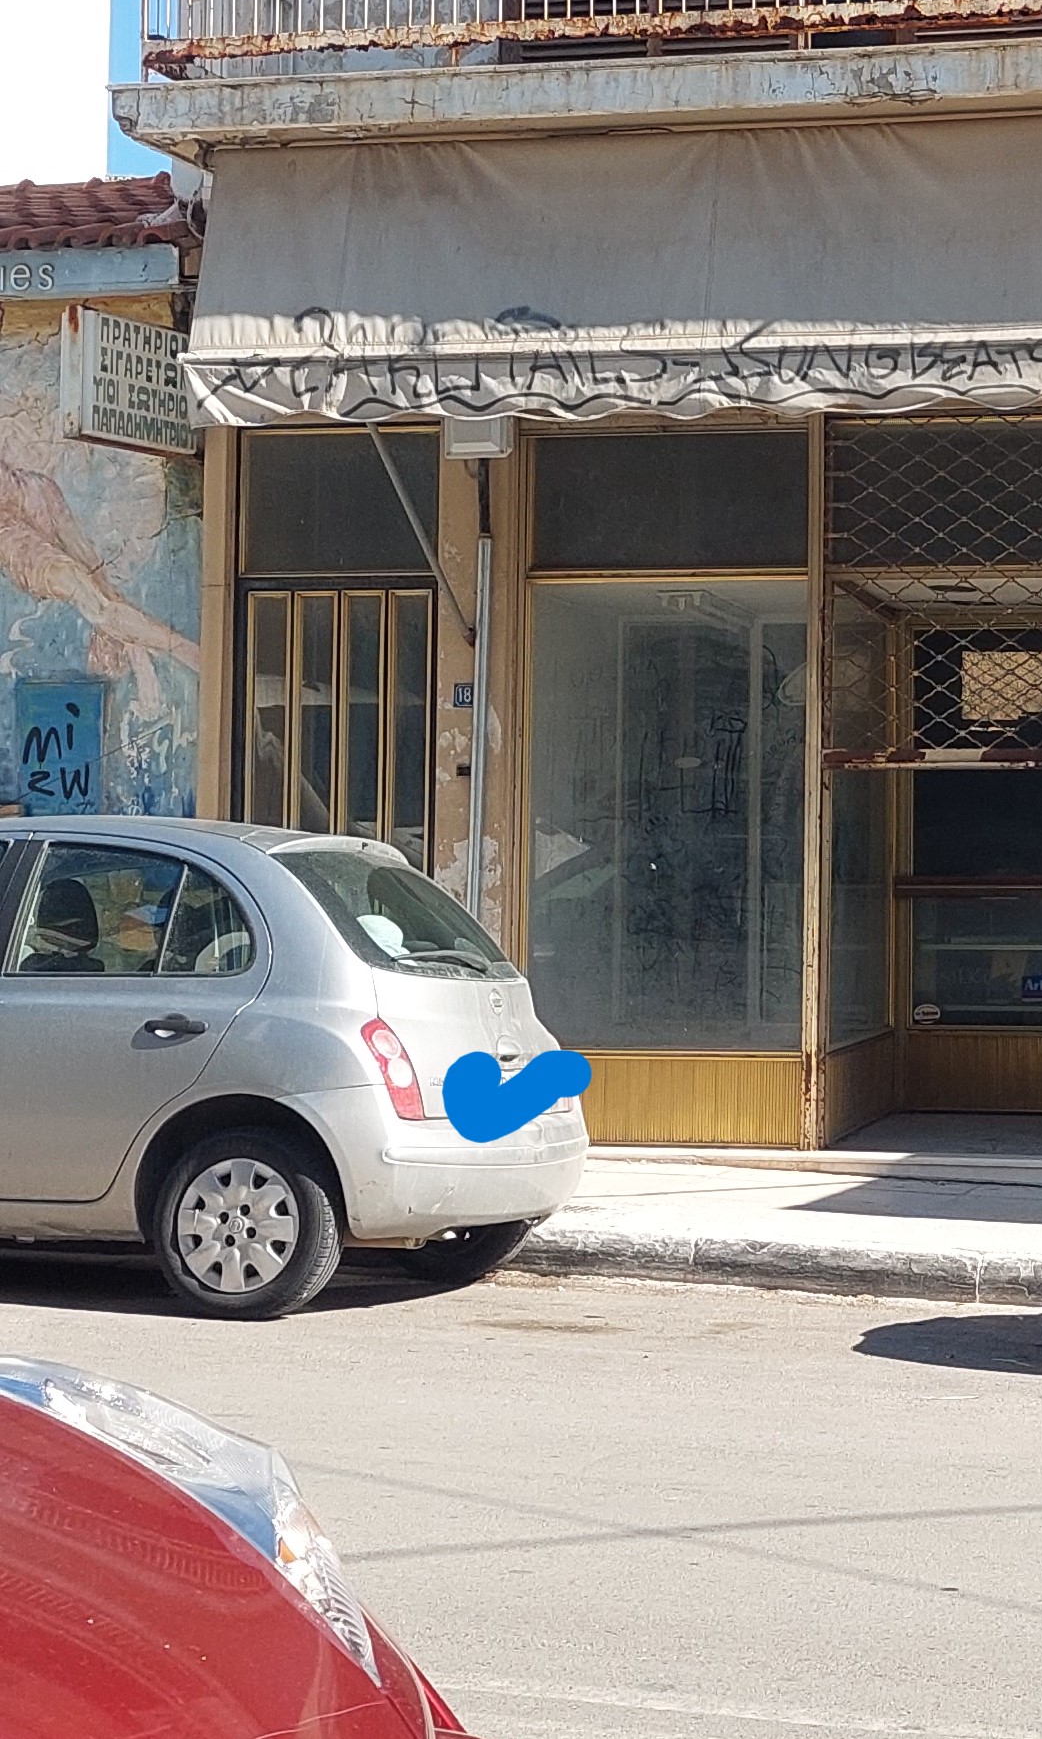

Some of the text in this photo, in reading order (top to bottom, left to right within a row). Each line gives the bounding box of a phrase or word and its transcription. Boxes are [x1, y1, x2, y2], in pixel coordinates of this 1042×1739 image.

[92, 375, 188, 420] ΥΙΟΙ ΣΩΤΗΡΙΟ
[457, 687, 472, 703] 18
